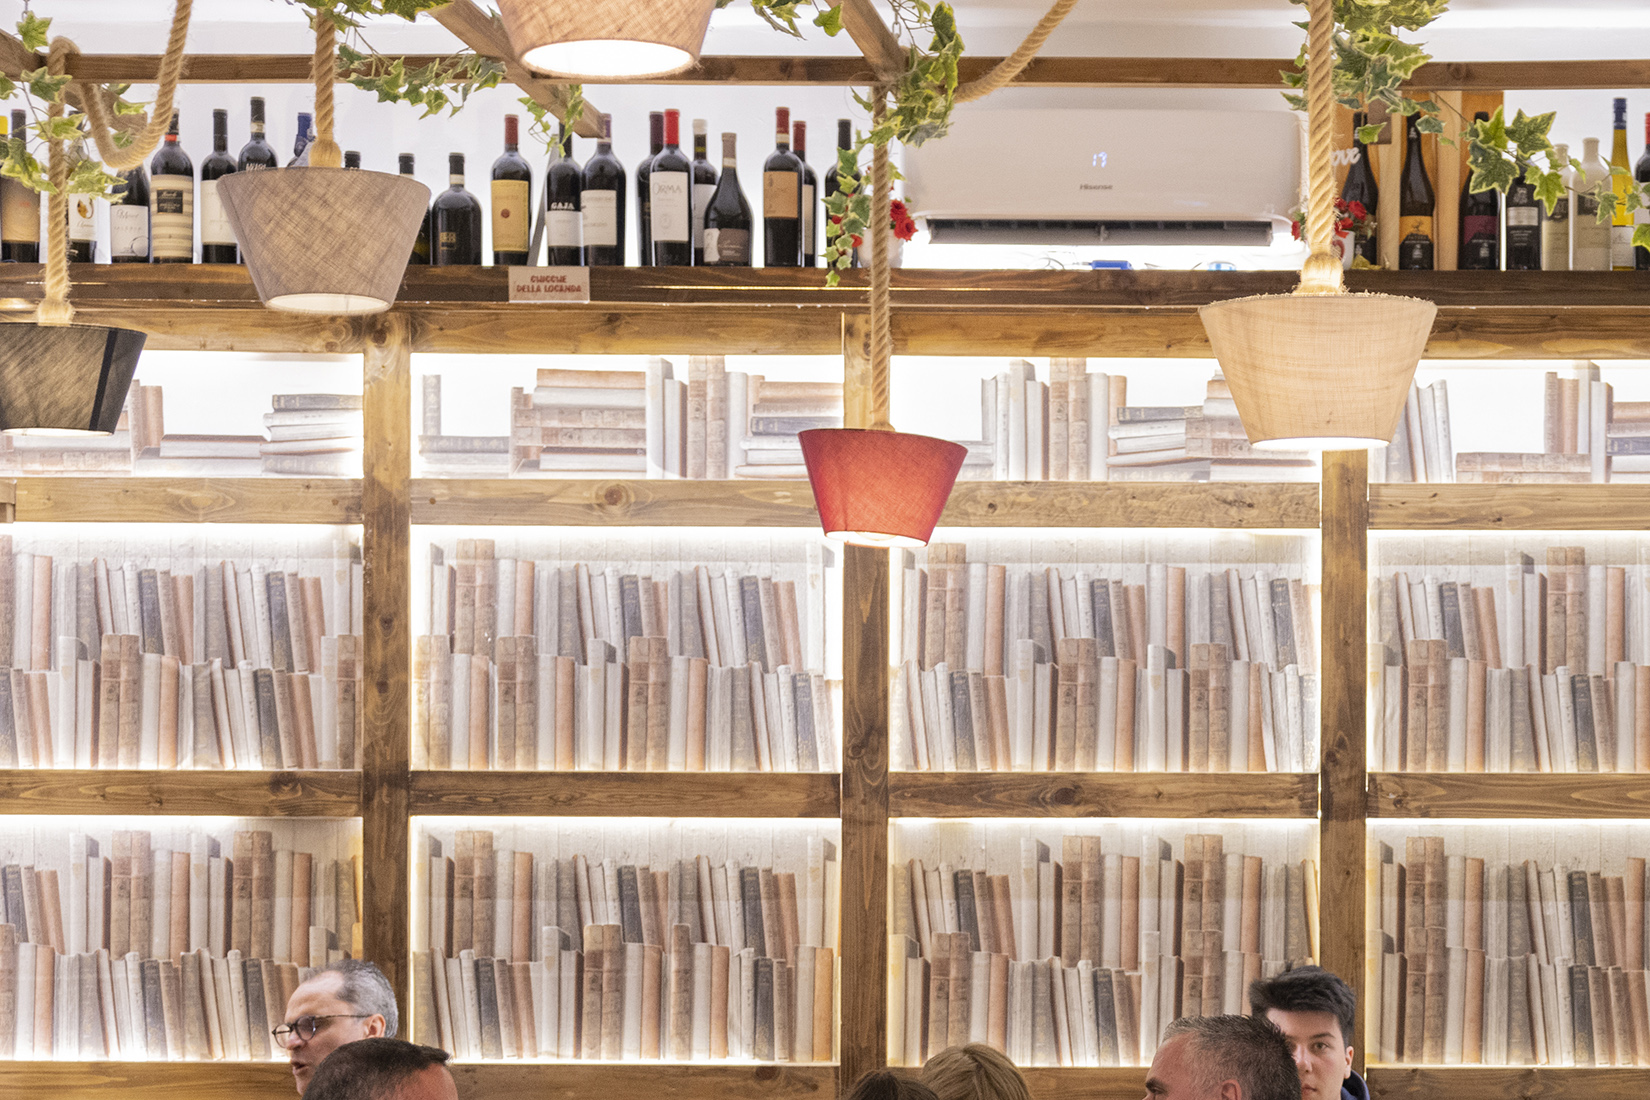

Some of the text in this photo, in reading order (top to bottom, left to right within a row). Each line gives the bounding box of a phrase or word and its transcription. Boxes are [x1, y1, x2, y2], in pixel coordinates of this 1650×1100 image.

[1092, 151, 1108, 168] 17
[1331, 147, 1362, 167] ove
[550, 201, 575, 210] GAJA
[530, 274, 567, 283] CHICCHE
[517, 285, 582, 293] DELLA LOCANDA
